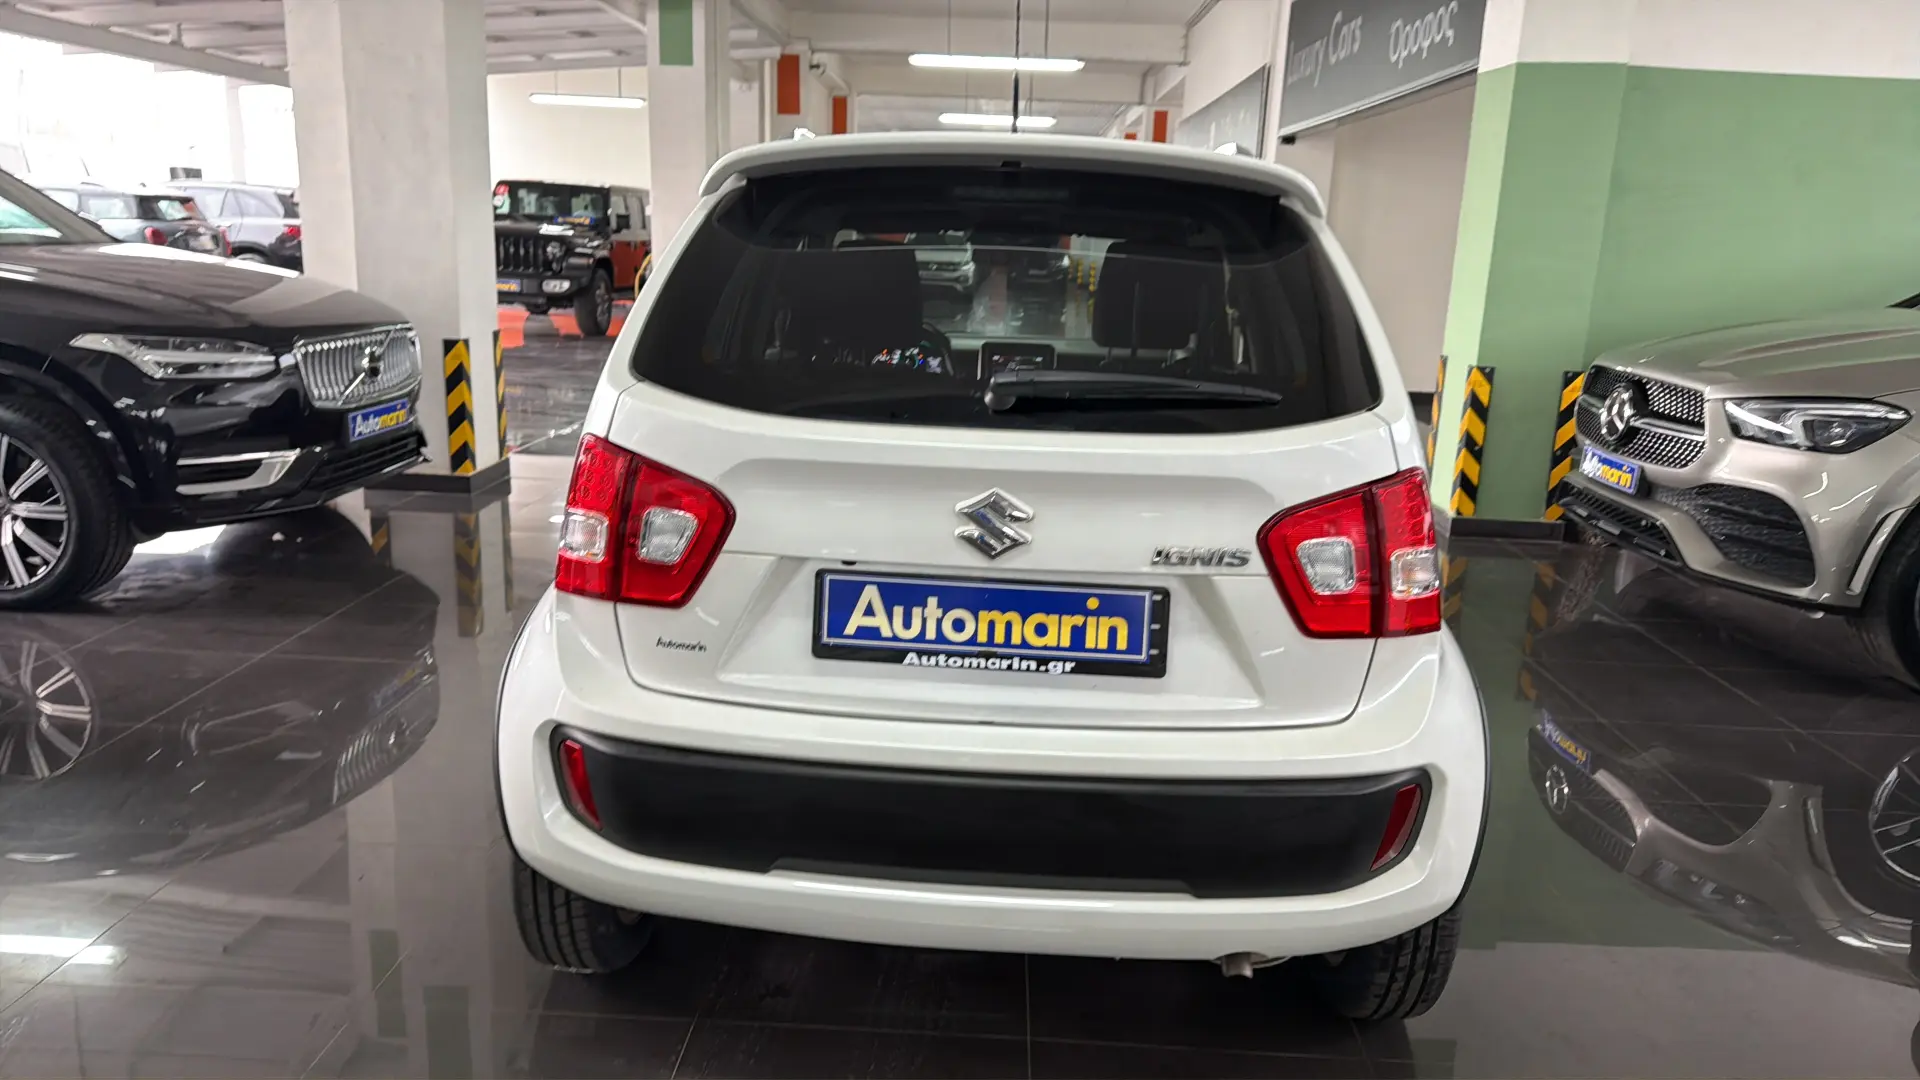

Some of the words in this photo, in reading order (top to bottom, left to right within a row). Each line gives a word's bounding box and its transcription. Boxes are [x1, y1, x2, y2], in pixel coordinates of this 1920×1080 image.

[1328, 10, 1363, 66] Cars
[354, 404, 407, 437] Automarin
[1152, 546, 1252, 567] IGNIS
[843, 583, 1129, 651] Automarin
[902, 652, 1076, 674] Automarin.gr
